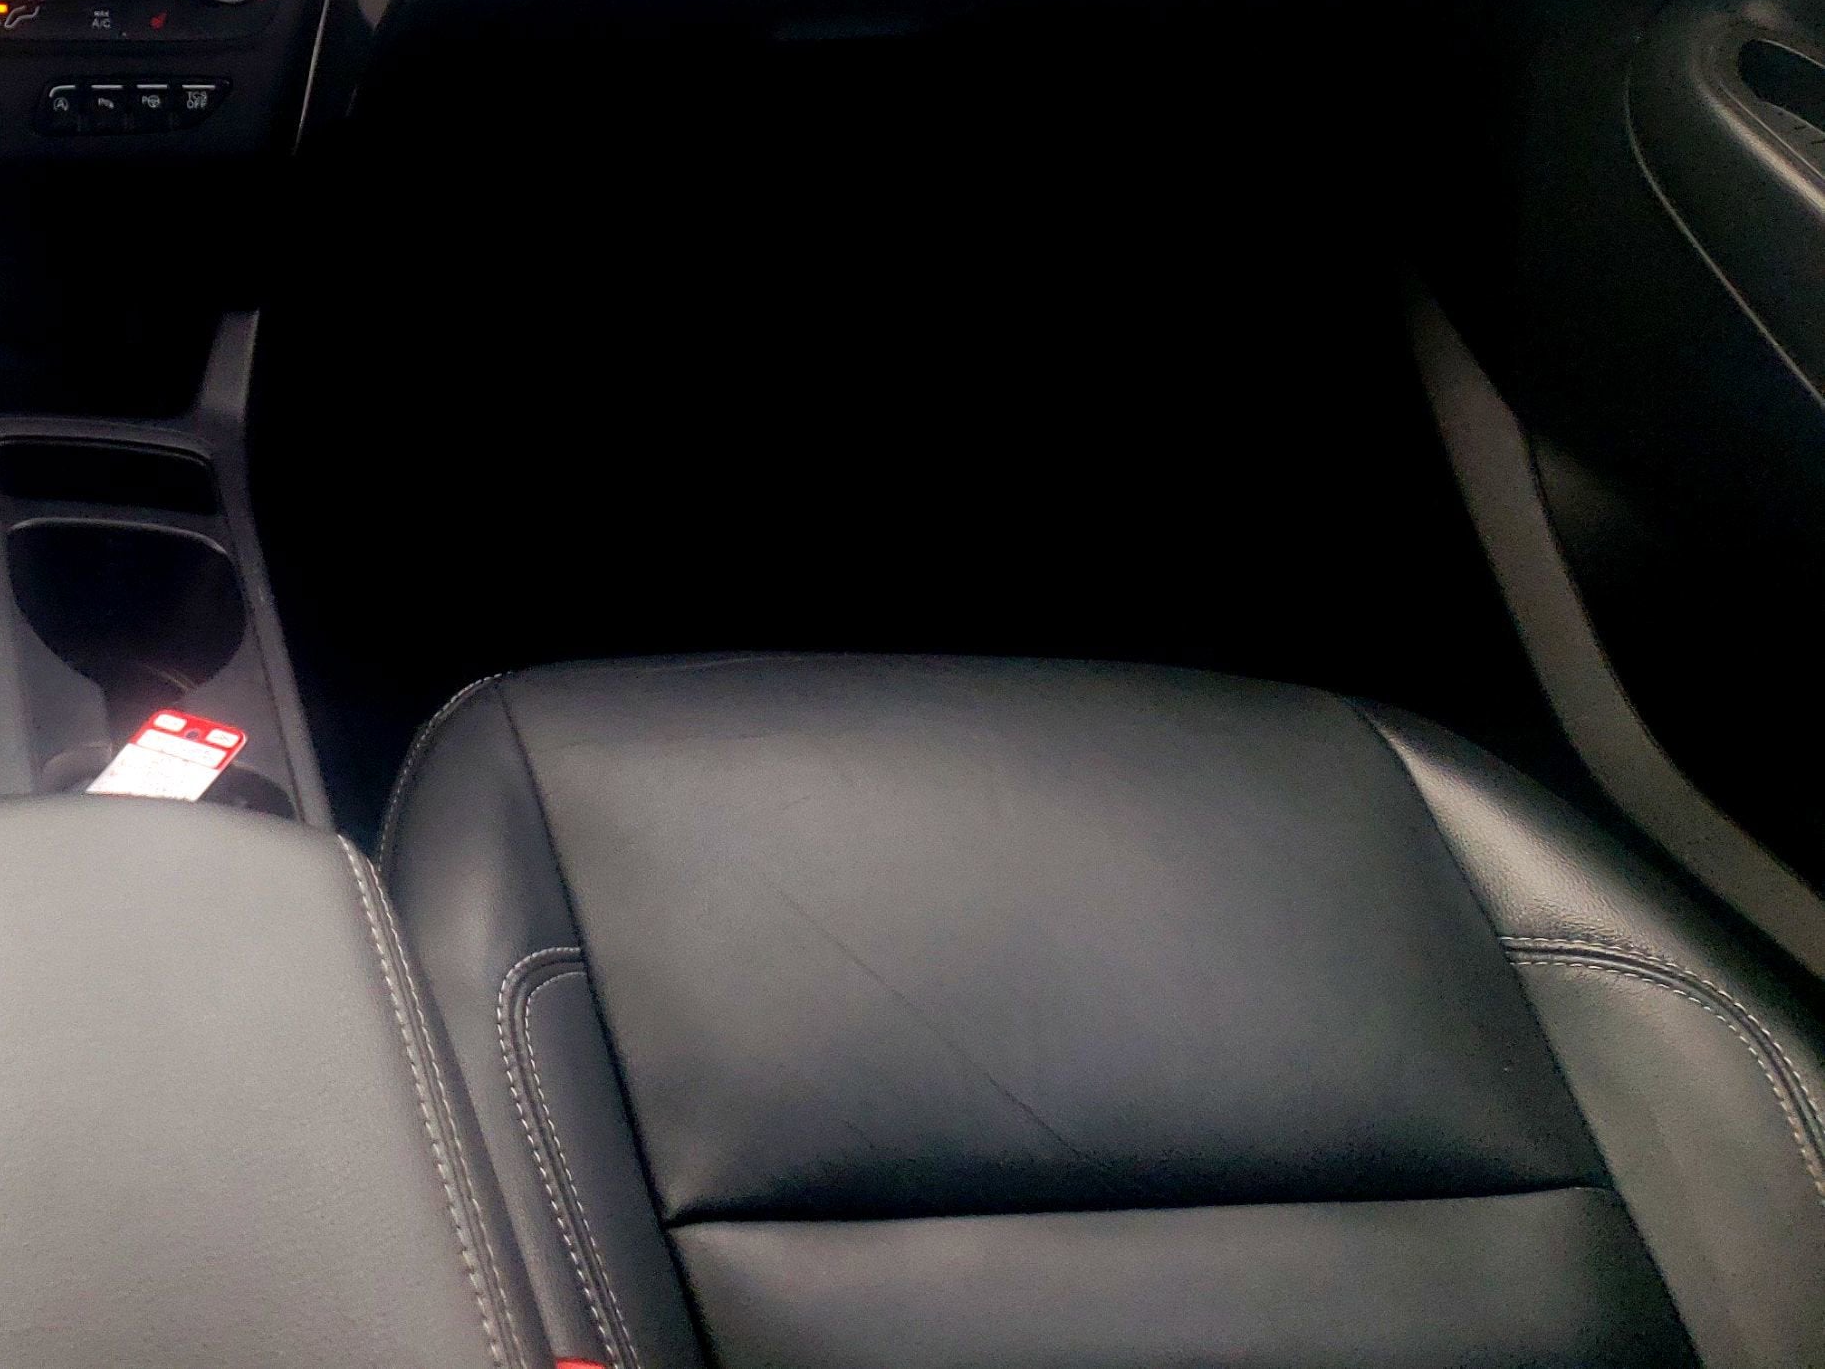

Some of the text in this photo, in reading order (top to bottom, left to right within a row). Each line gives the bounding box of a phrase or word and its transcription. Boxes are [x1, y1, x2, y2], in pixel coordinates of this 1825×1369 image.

[92, 17, 111, 29] A/C
[186, 91, 207, 101] TCS
[186, 99, 207, 109] OFF
